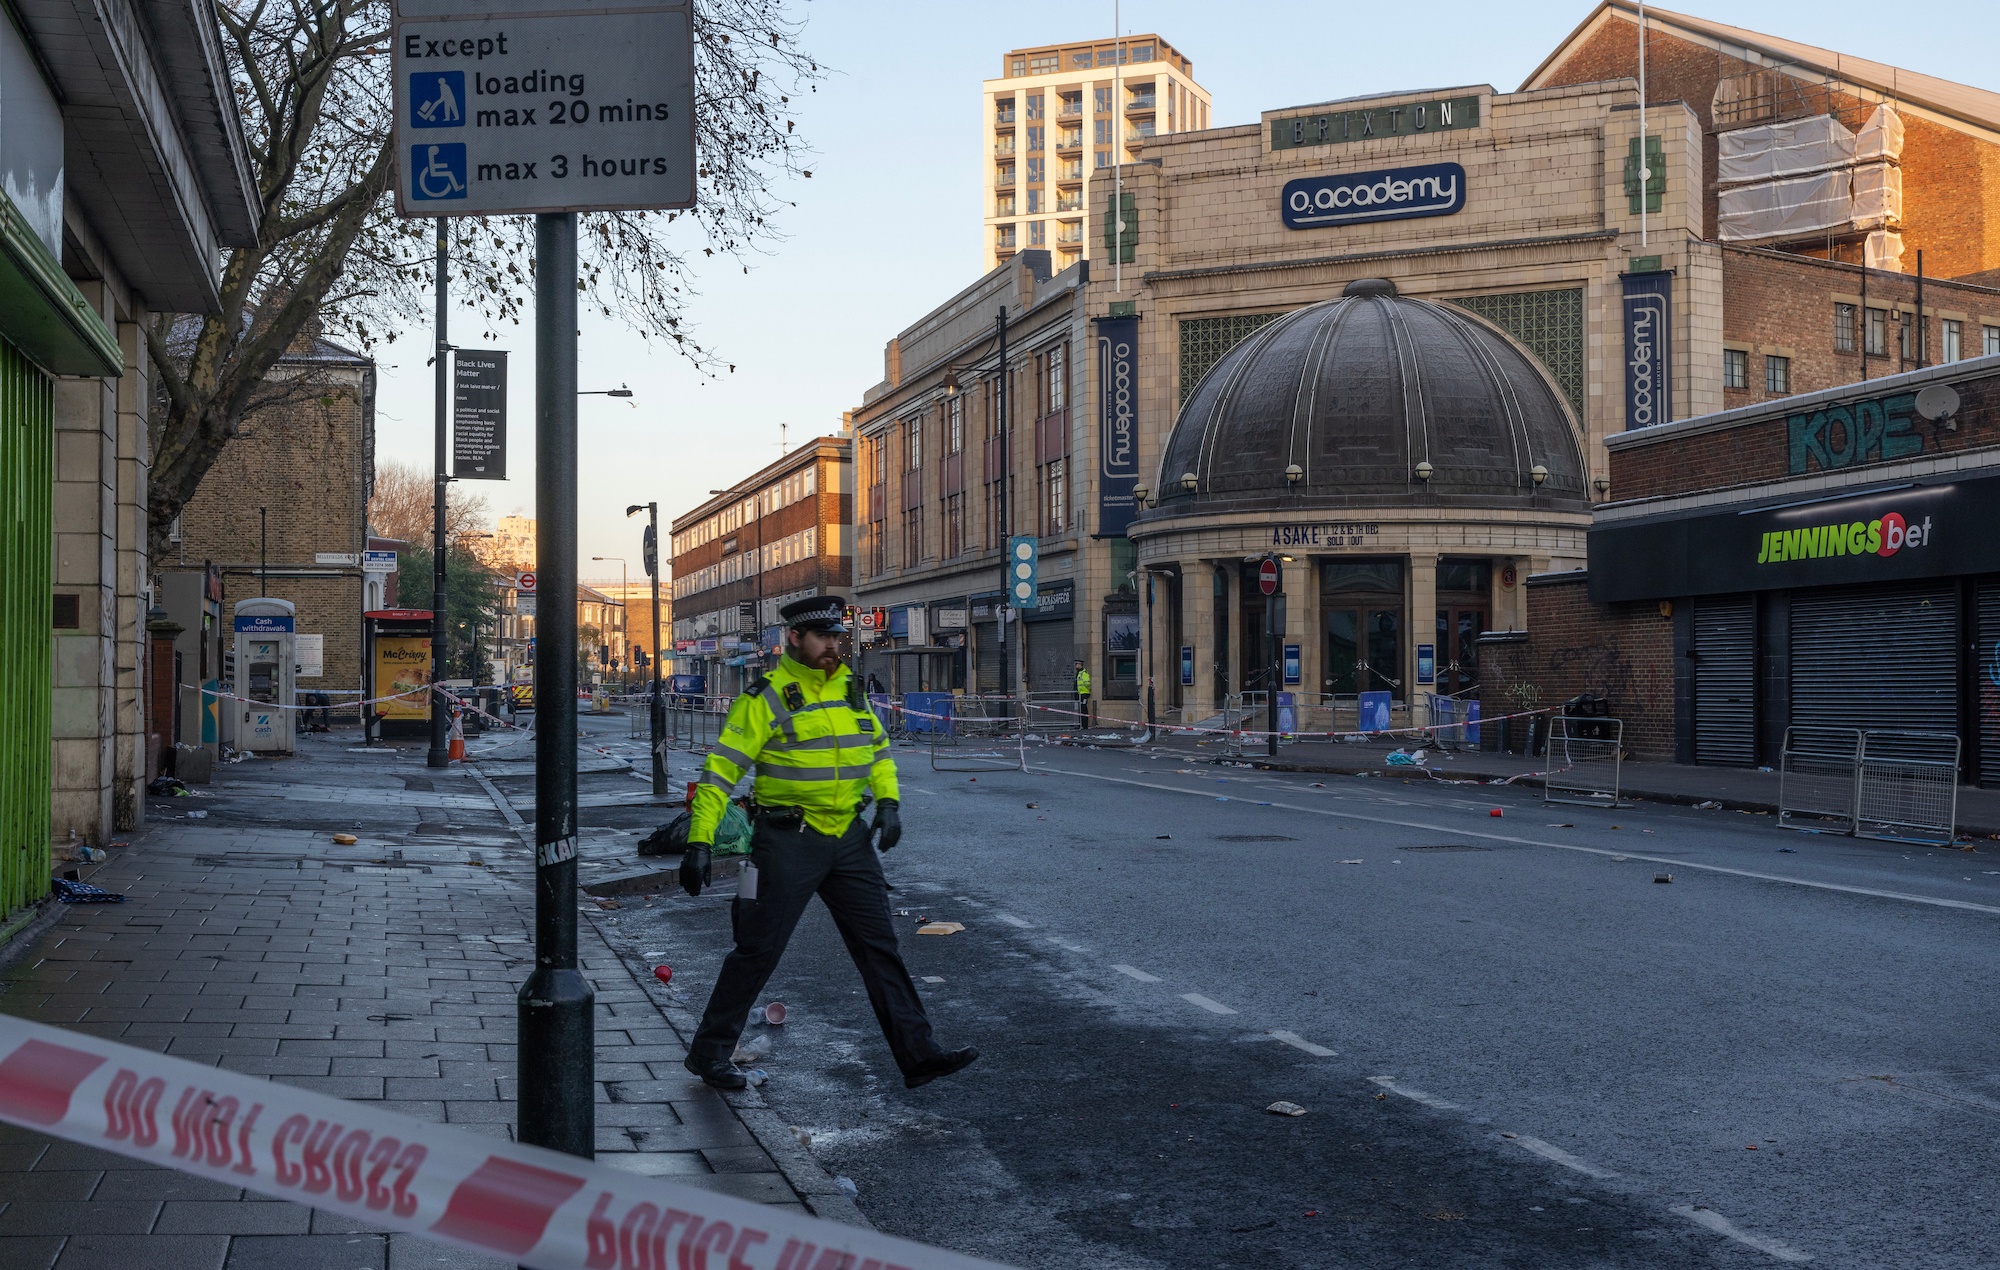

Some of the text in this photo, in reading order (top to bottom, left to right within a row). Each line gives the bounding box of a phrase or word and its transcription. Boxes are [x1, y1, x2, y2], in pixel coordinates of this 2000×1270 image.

[405, 32, 508, 59] Except
[475, 69, 585, 96] loading
[476, 98, 669, 127] max 20 mins
[1293, 101, 1453, 144] BRIXTON
[477, 154, 668, 181] max 3 hours
[1314, 174, 1457, 210] academy
[457, 360, 476, 368] Black
[1629, 307, 1652, 424] academy
[1786, 391, 1924, 476] KOPE
[1273, 525, 1319, 545] ASAKE
[1327, 535, 1364, 546] SOLD OUT
[1332, 525, 1339, 535] 12
[1340, 525, 1346, 535] &
[1366, 524, 1379, 535] DEC
[383, 647, 427, 663] McCrispy
